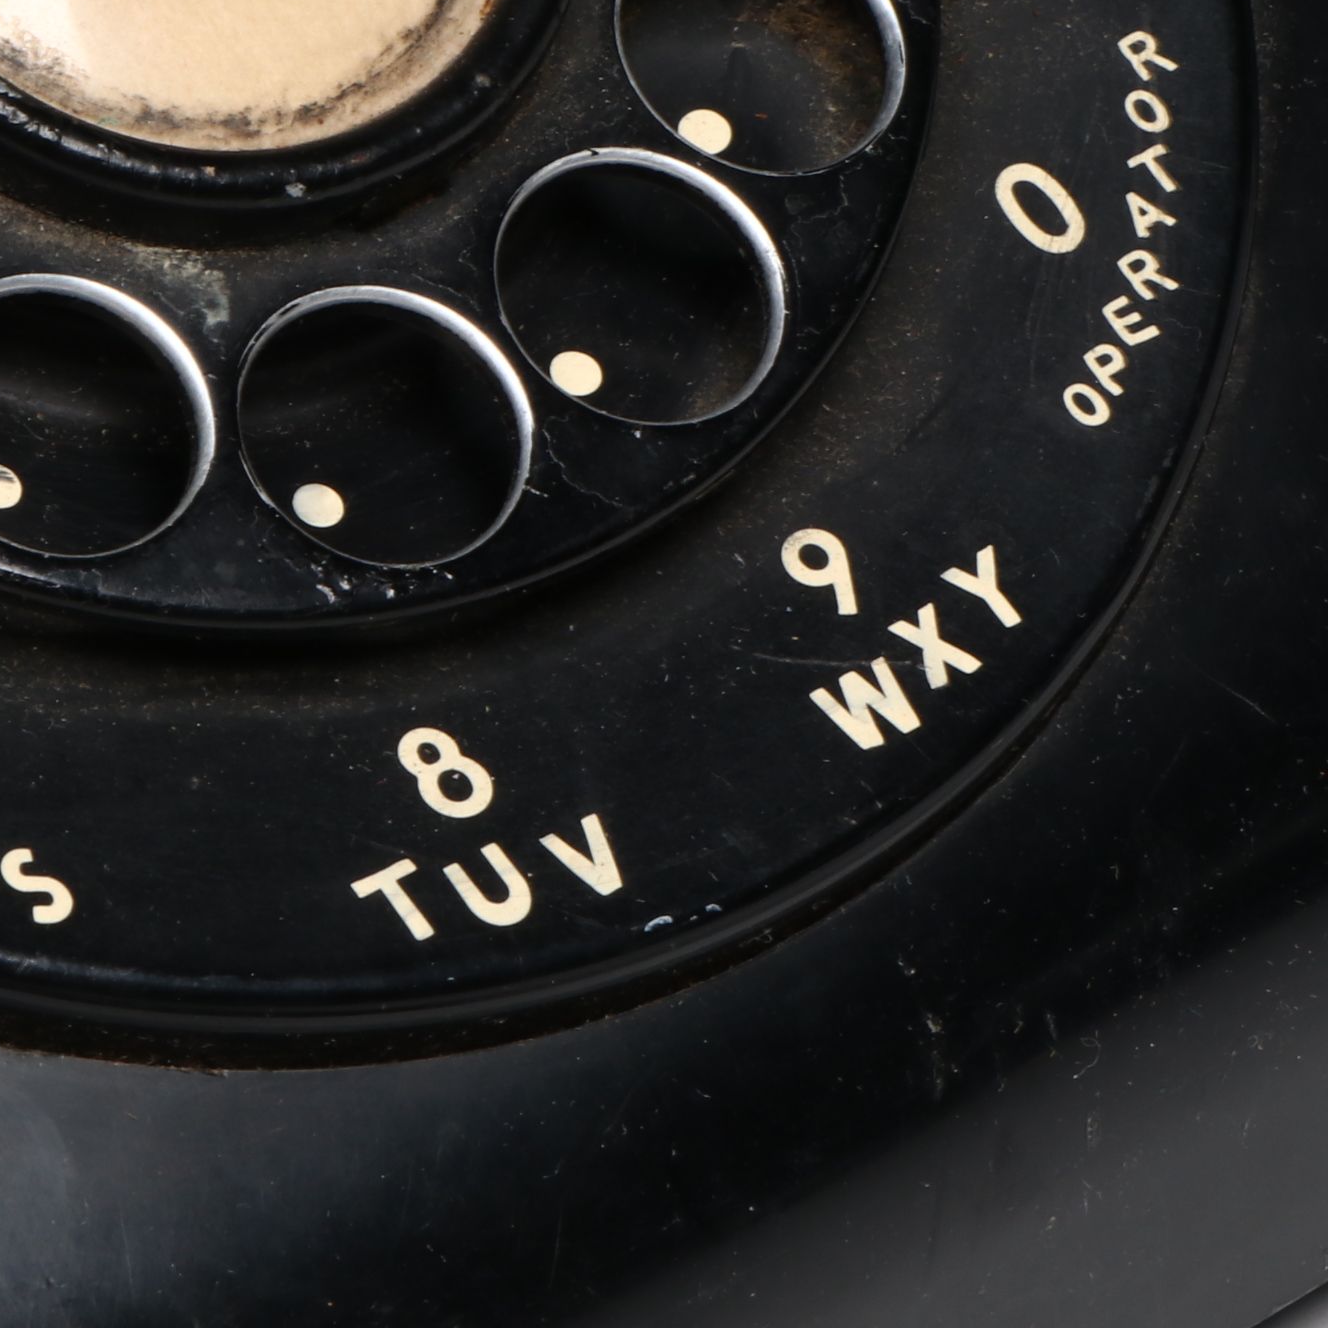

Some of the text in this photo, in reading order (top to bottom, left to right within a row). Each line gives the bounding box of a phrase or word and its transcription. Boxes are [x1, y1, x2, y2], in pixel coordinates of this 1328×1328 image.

[1062, 32, 1178, 426] OPERATOR
[783, 530, 858, 614] 9
[808, 544, 1021, 749] WXY
[398, 729, 494, 818] 8
[352, 814, 623, 940] TUV
